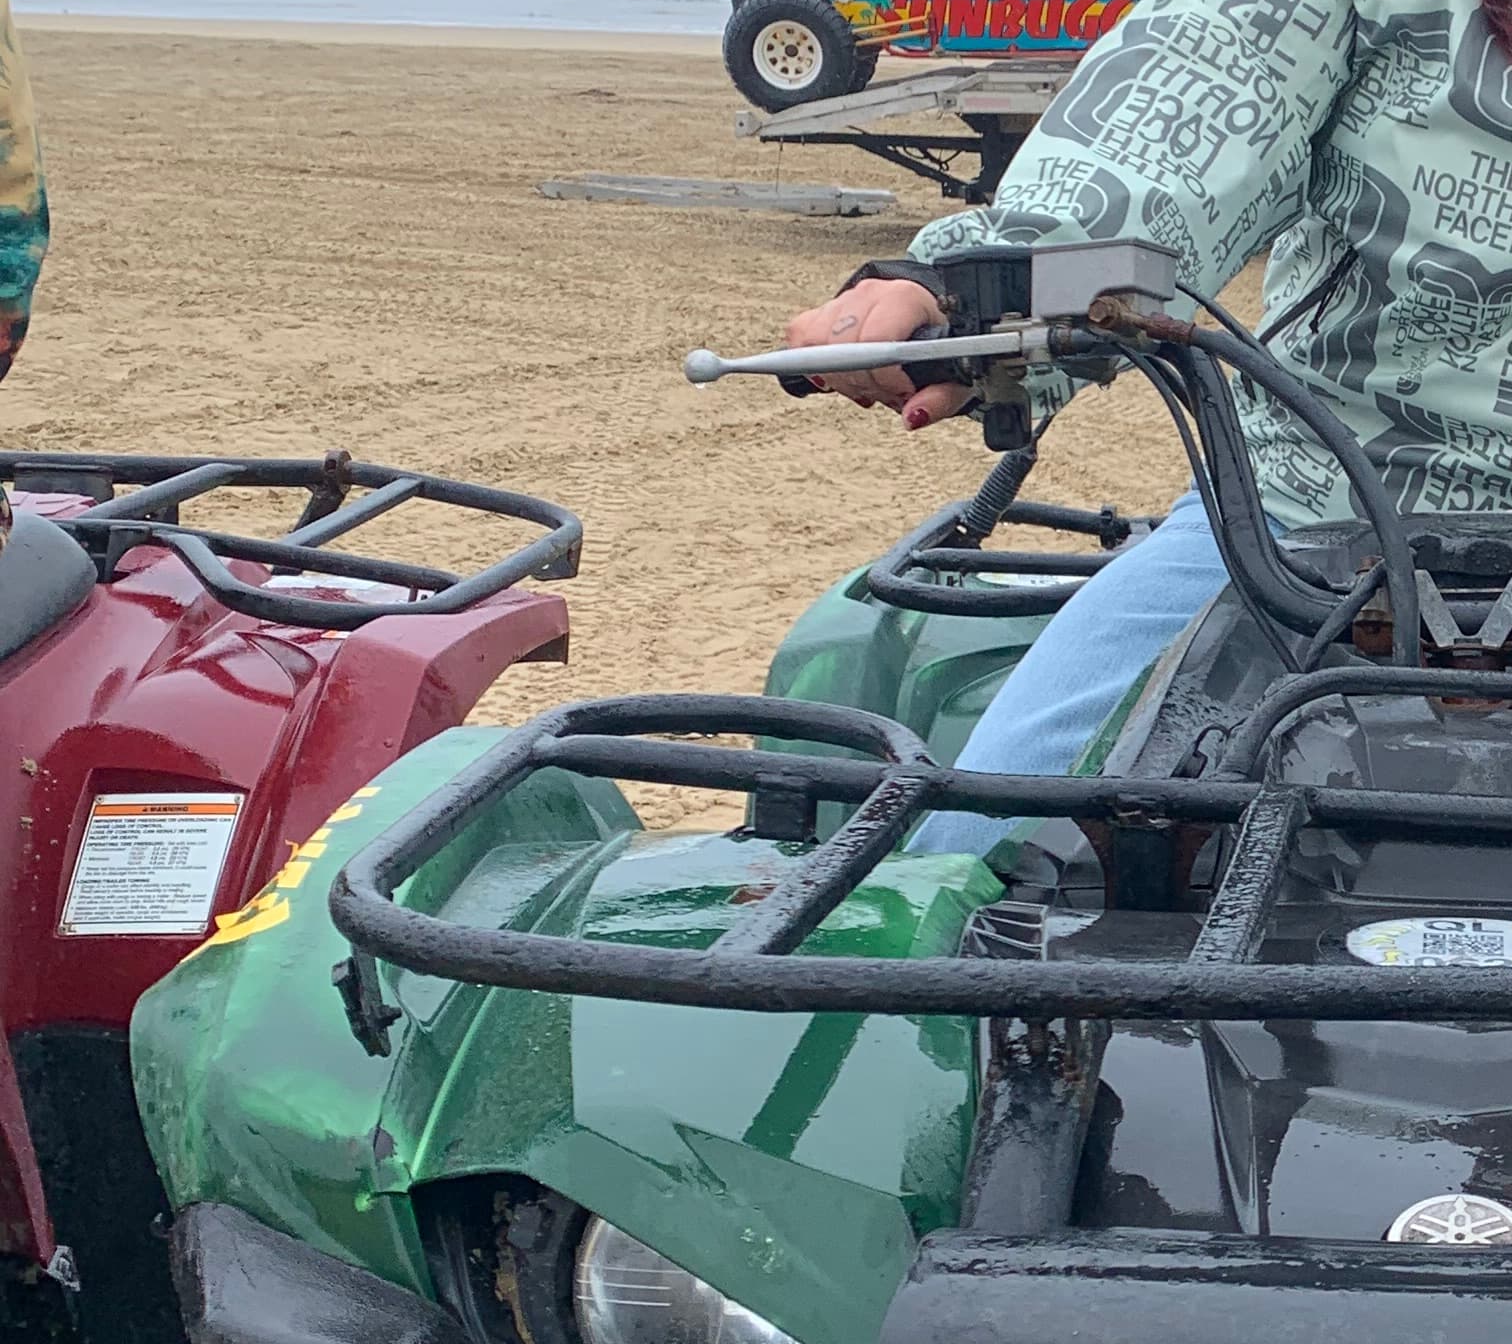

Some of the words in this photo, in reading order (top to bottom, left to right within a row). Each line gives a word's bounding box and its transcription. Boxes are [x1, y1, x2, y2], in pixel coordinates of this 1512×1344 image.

[1038, 156, 1094, 182] THE
[999, 180, 1080, 205] ORTH
[1434, 203, 1512, 252] FACE
[1424, 920, 1504, 932] QL
